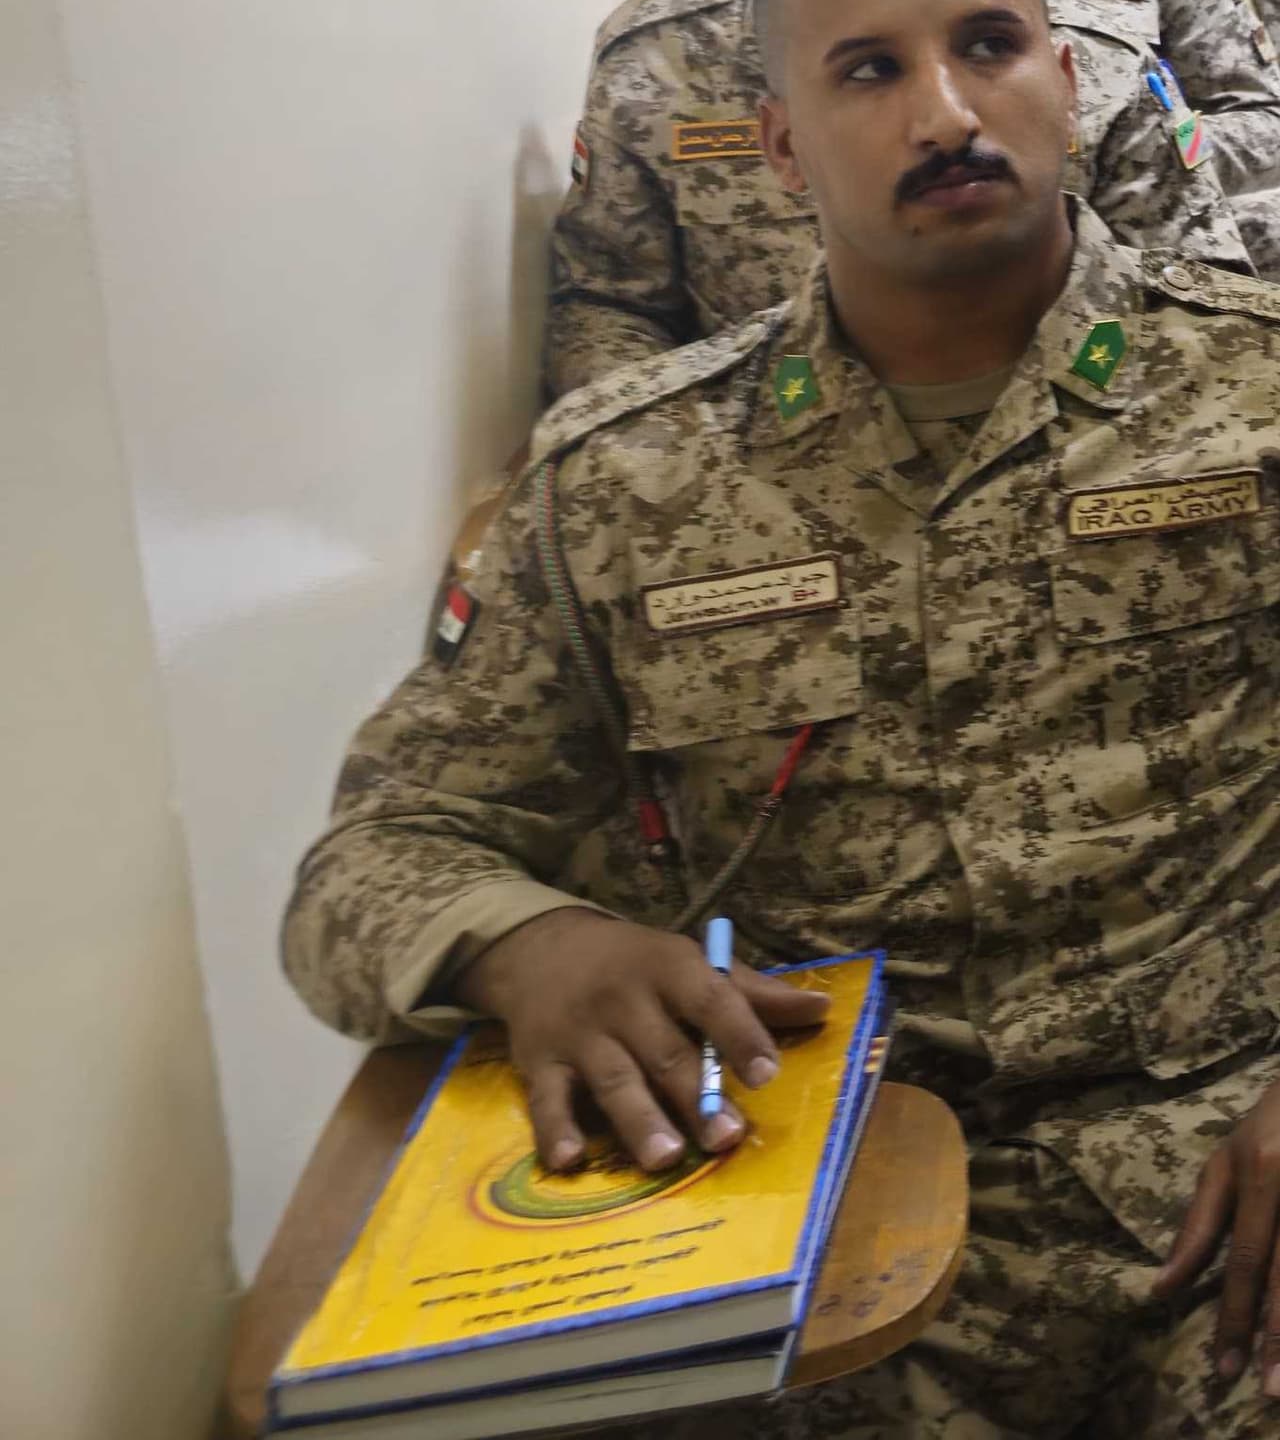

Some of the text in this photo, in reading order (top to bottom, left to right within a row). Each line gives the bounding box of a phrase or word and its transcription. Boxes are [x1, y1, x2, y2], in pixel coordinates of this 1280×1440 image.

[1076, 480, 1251, 514] الجيش العراقي
[1076, 495, 1251, 531] IRAQ ARMY
